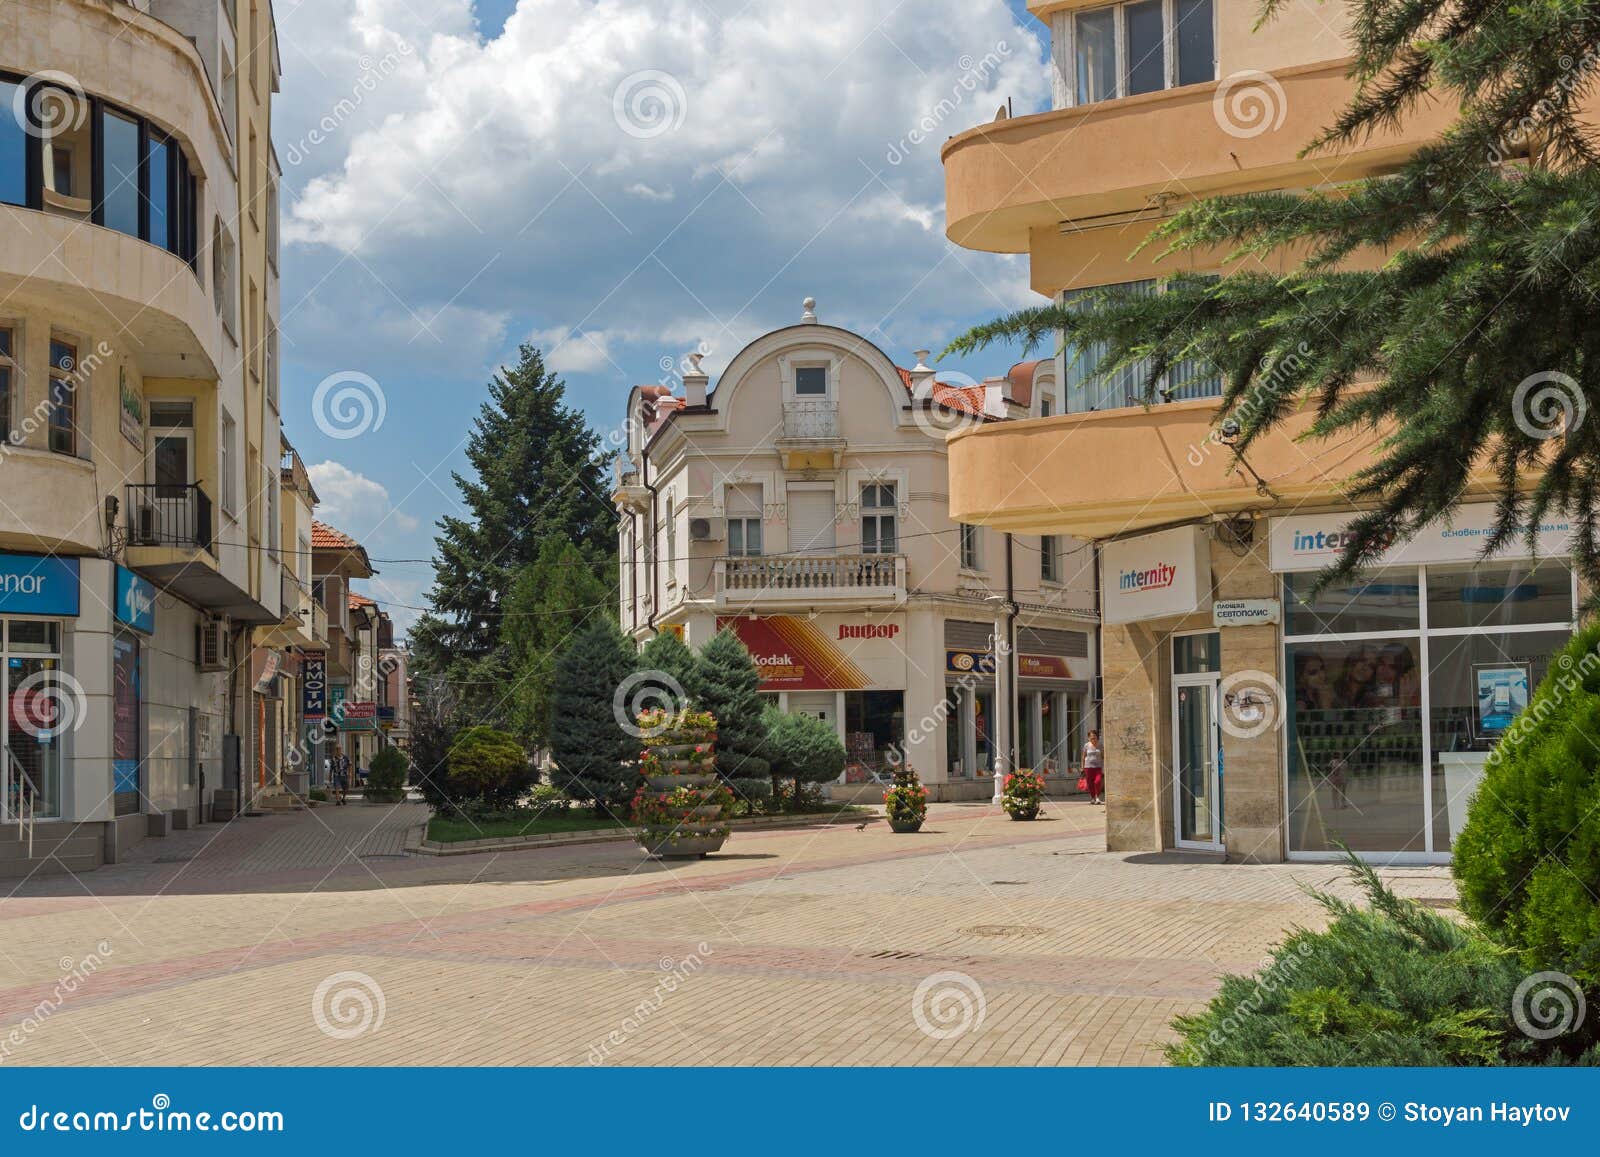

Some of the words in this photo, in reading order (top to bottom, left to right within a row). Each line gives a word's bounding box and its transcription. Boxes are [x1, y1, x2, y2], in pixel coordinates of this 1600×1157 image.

[1119, 562, 1176, 587] internity
[1216, 608, 1269, 619] СЕВТОПОЛИС
[751, 653, 793, 667] Kodak
[304, 661, 325, 709] ИМОТИ
